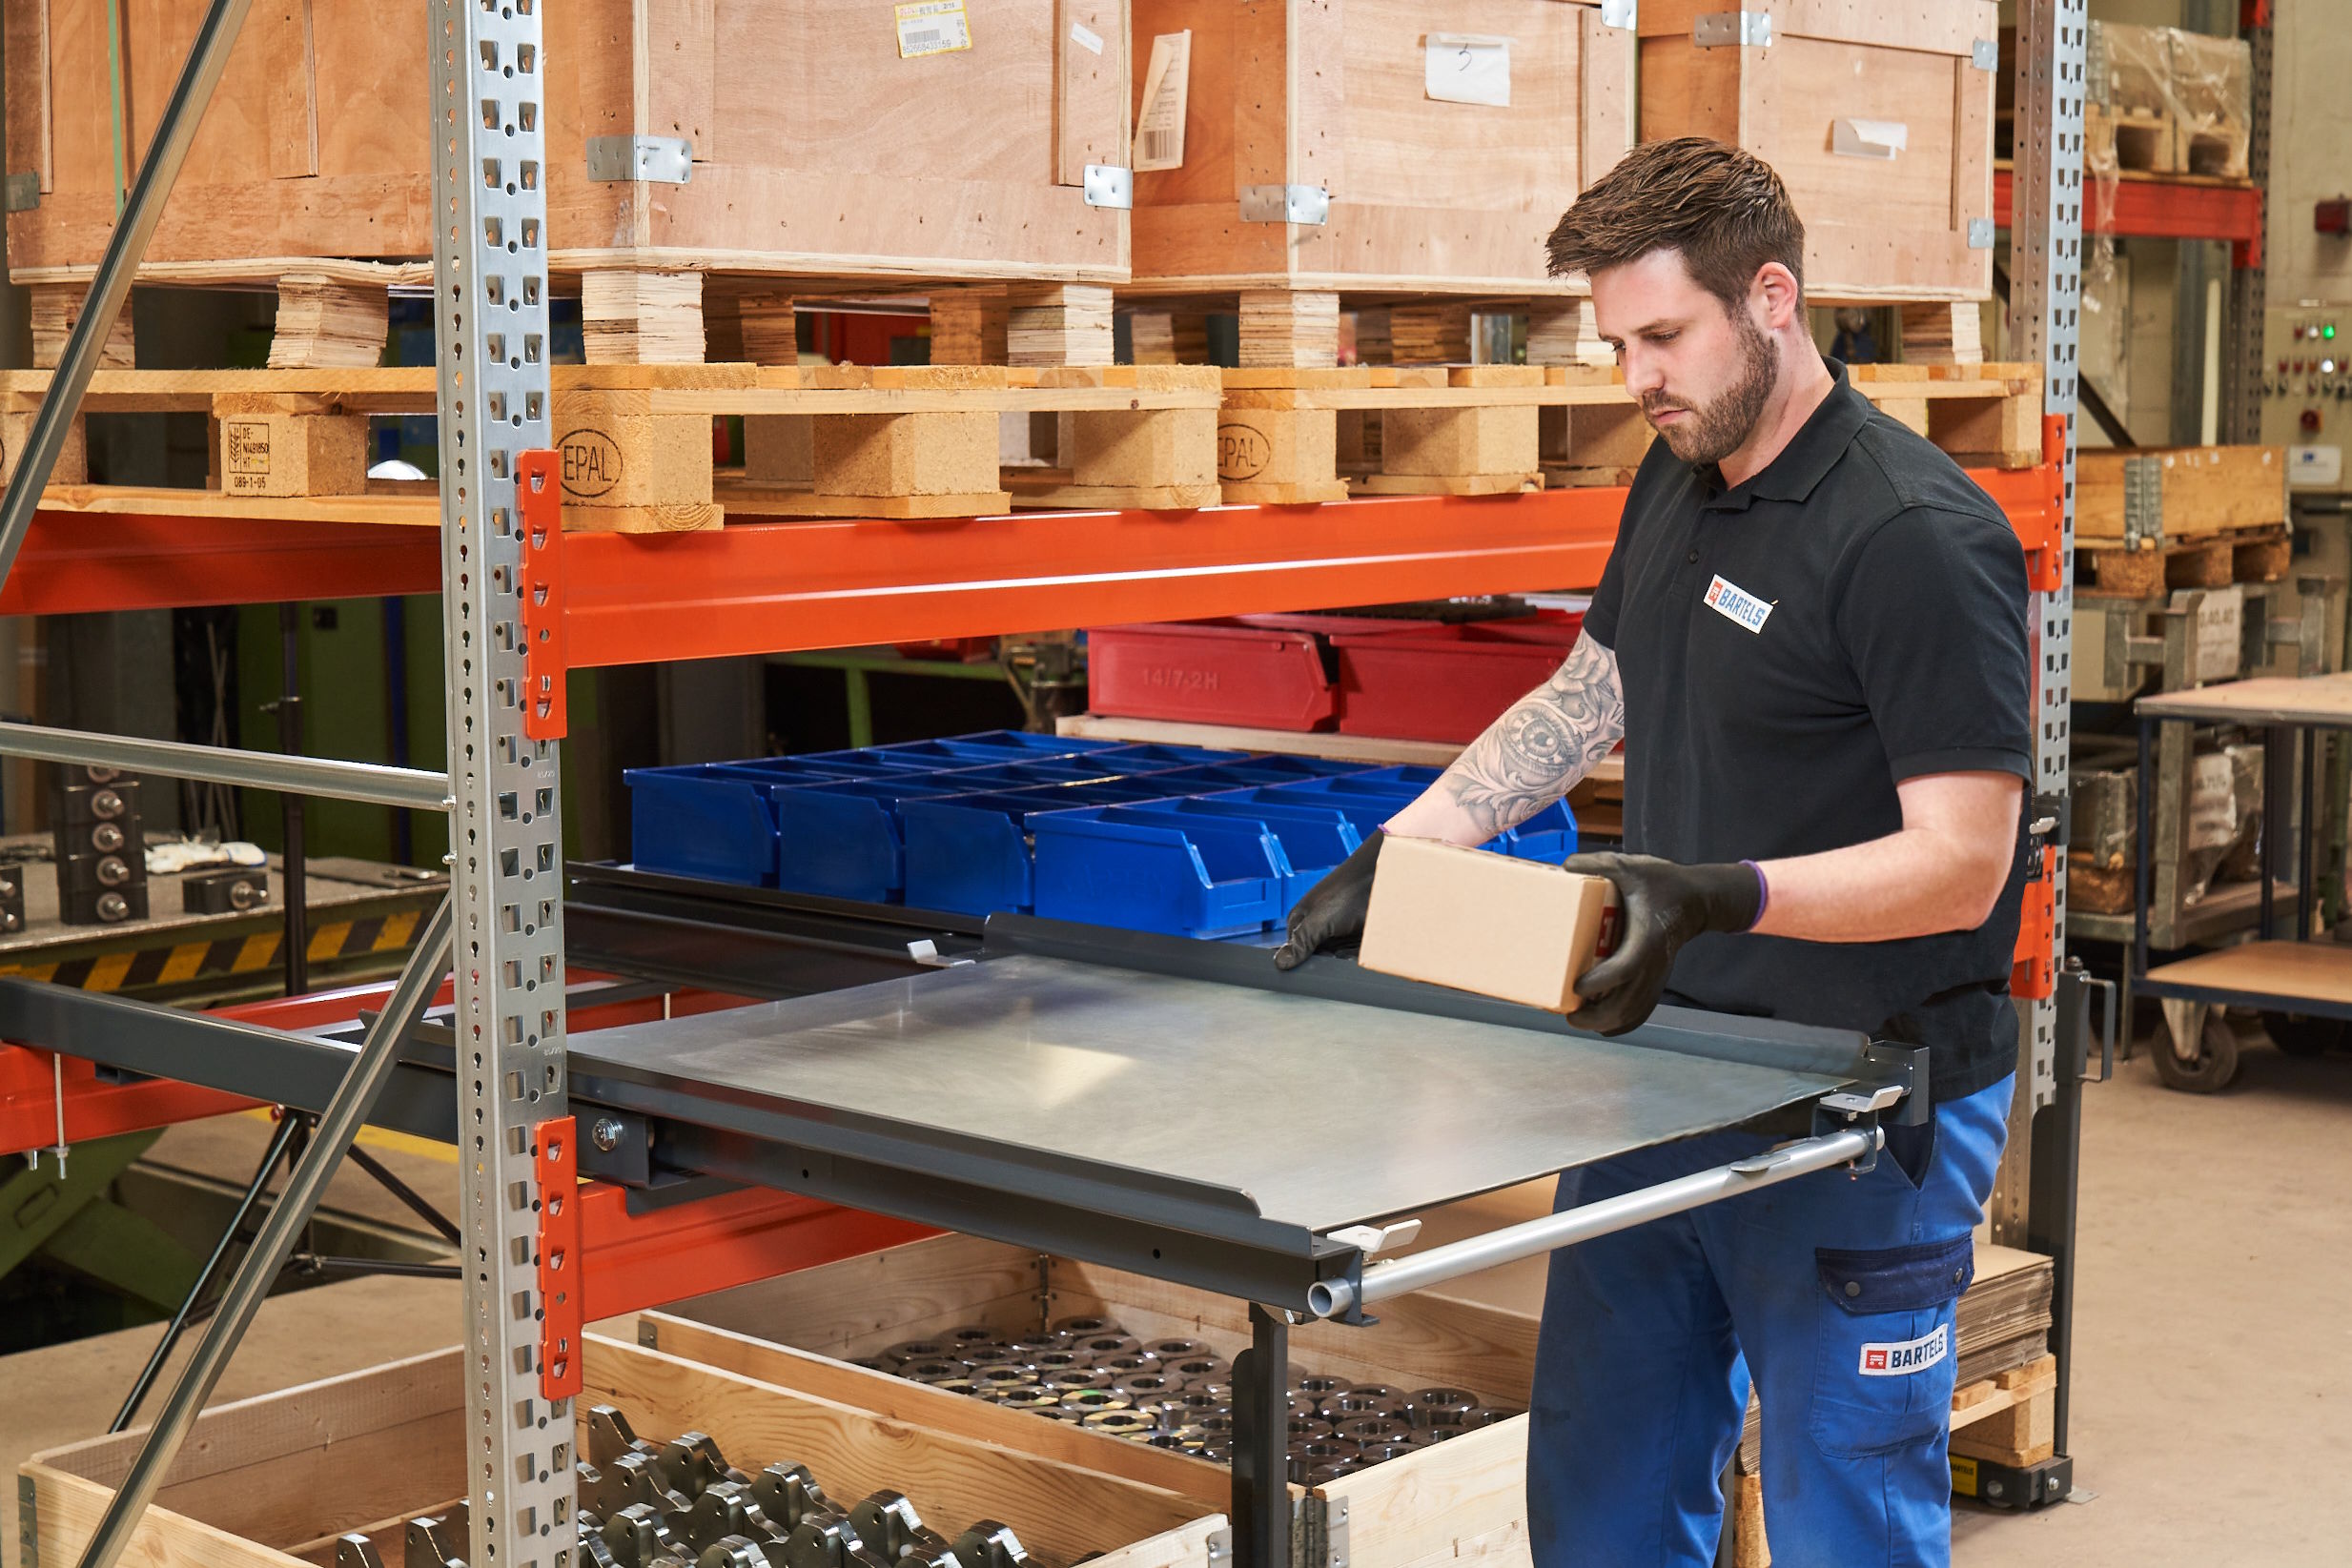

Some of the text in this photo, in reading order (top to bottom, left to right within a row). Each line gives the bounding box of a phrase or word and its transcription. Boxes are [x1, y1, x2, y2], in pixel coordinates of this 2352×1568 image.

[563, 444, 612, 482] EPAL
[1718, 588, 1766, 626] BARTELS
[1891, 1333, 1944, 1369] BARTELS
